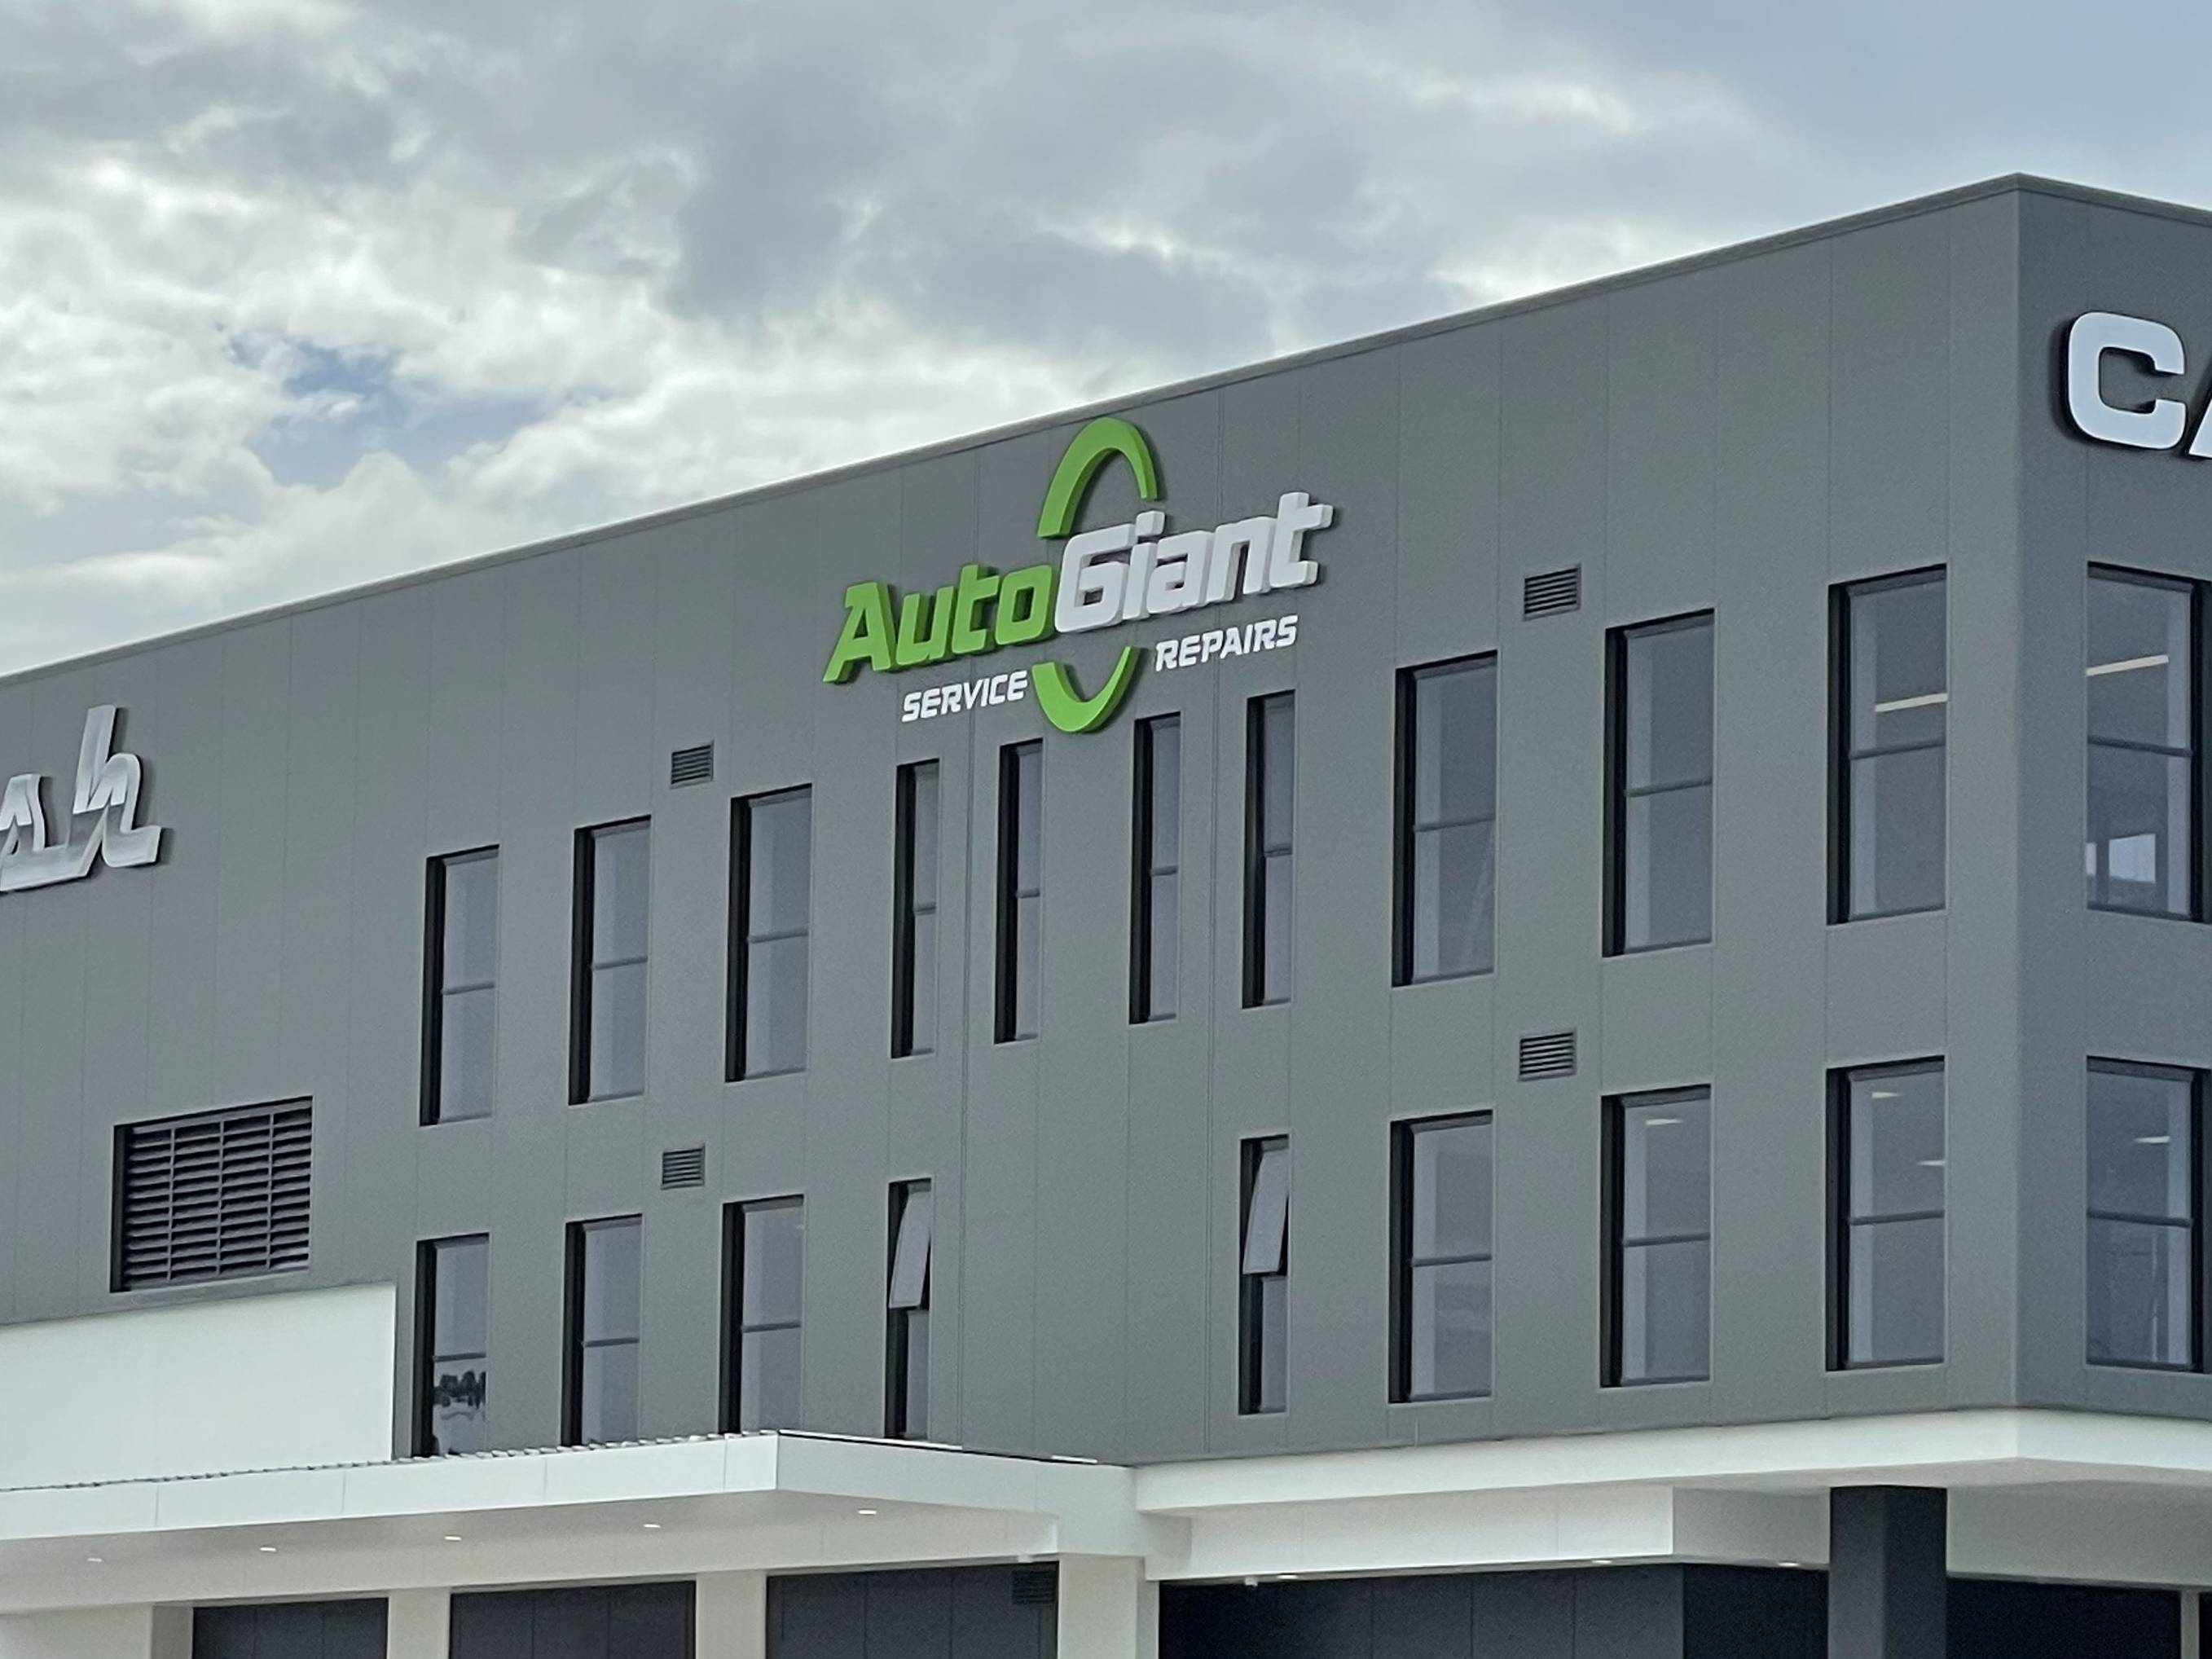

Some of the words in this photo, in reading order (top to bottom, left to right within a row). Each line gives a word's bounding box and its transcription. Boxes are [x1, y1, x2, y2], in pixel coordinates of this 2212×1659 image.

[2067, 311, 2212, 459] C
[901, 670, 1028, 723] SERVICE
[1155, 614, 1299, 672] REPAIRS
